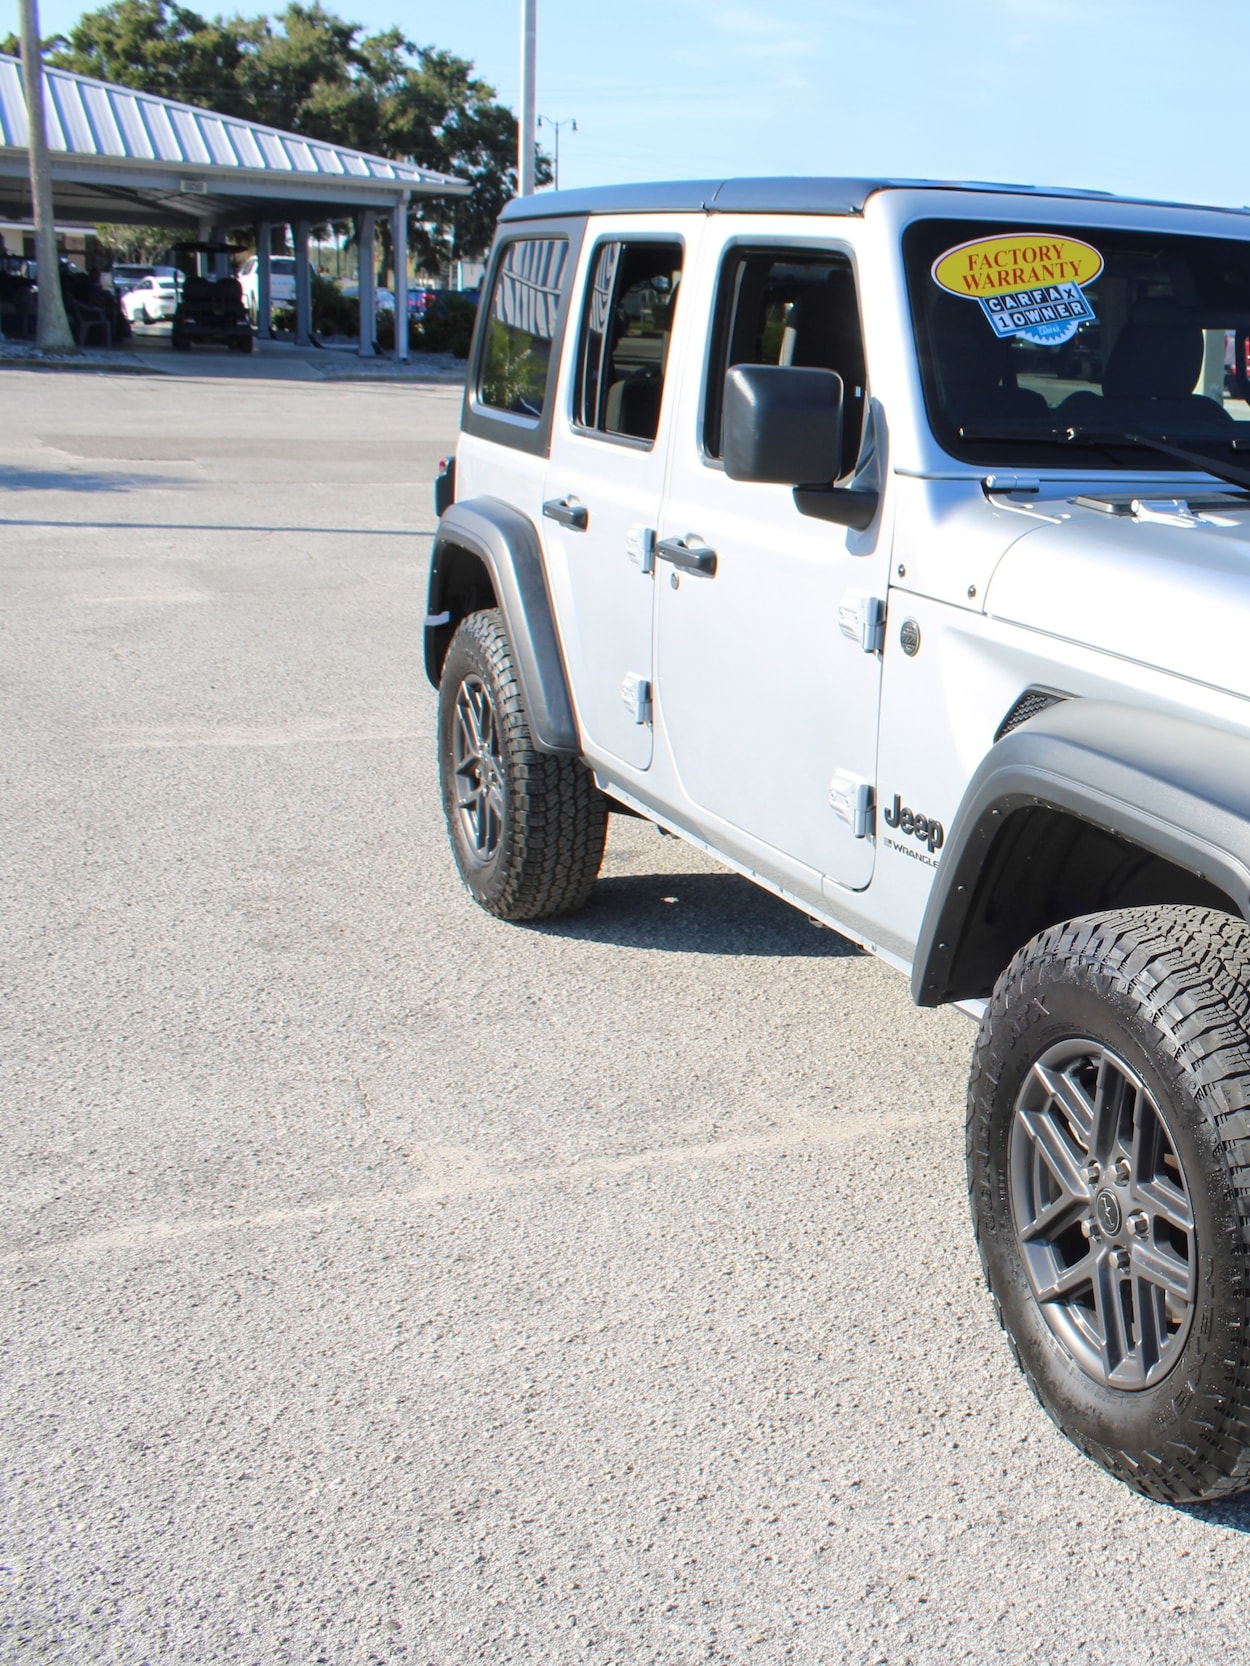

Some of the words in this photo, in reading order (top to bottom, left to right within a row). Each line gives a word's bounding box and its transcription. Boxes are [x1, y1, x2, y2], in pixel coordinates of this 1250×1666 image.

[967, 243, 1065, 271] FACTORY
[962, 260, 1082, 291] WARRANTY
[988, 286, 1076, 312] CARFAX
[998, 316, 1010, 329] 1
[1012, 302, 1085, 326] OWNER
[884, 793, 944, 853] Jeep
[892, 841, 940, 869] WRANGLE
